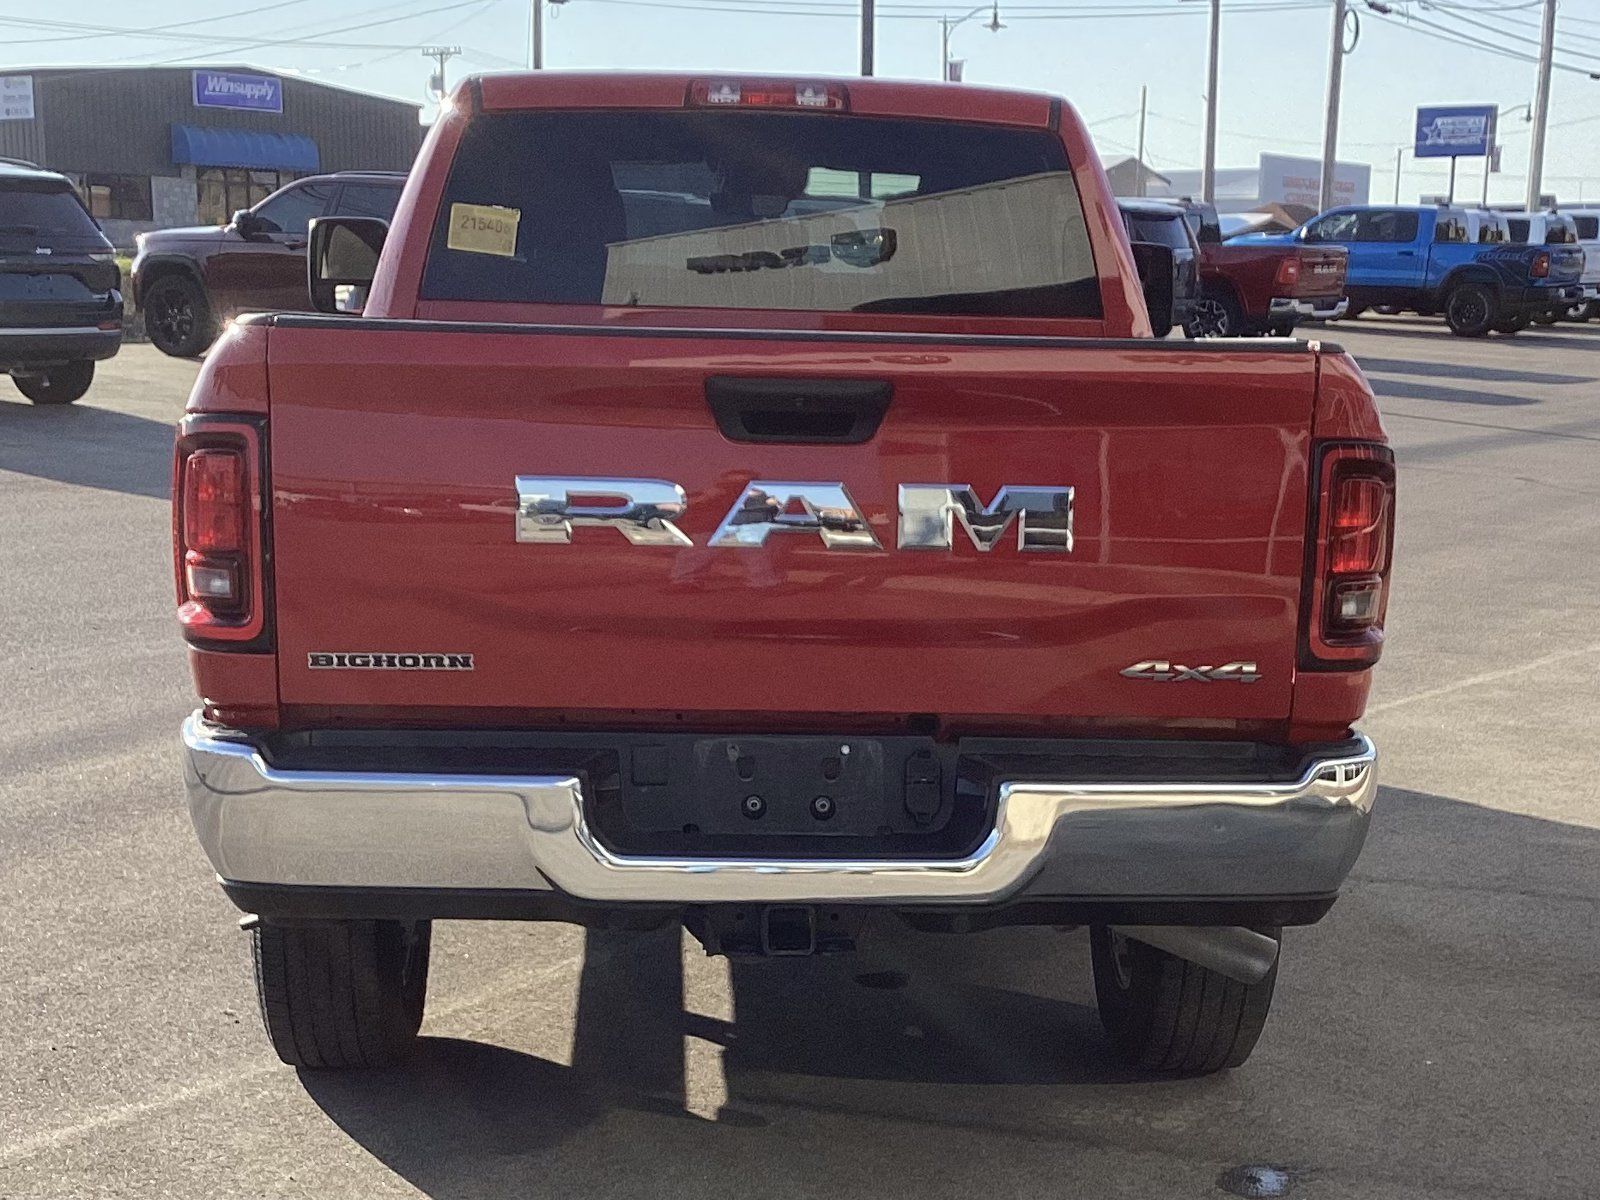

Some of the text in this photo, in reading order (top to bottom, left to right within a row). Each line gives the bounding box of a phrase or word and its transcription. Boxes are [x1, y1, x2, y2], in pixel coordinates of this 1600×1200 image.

[207, 76, 275, 100] Winsupply
[514, 475, 1075, 553] RAM
[307, 652, 474, 671] BIGHORN
[1119, 660, 1263, 683] 4x4
